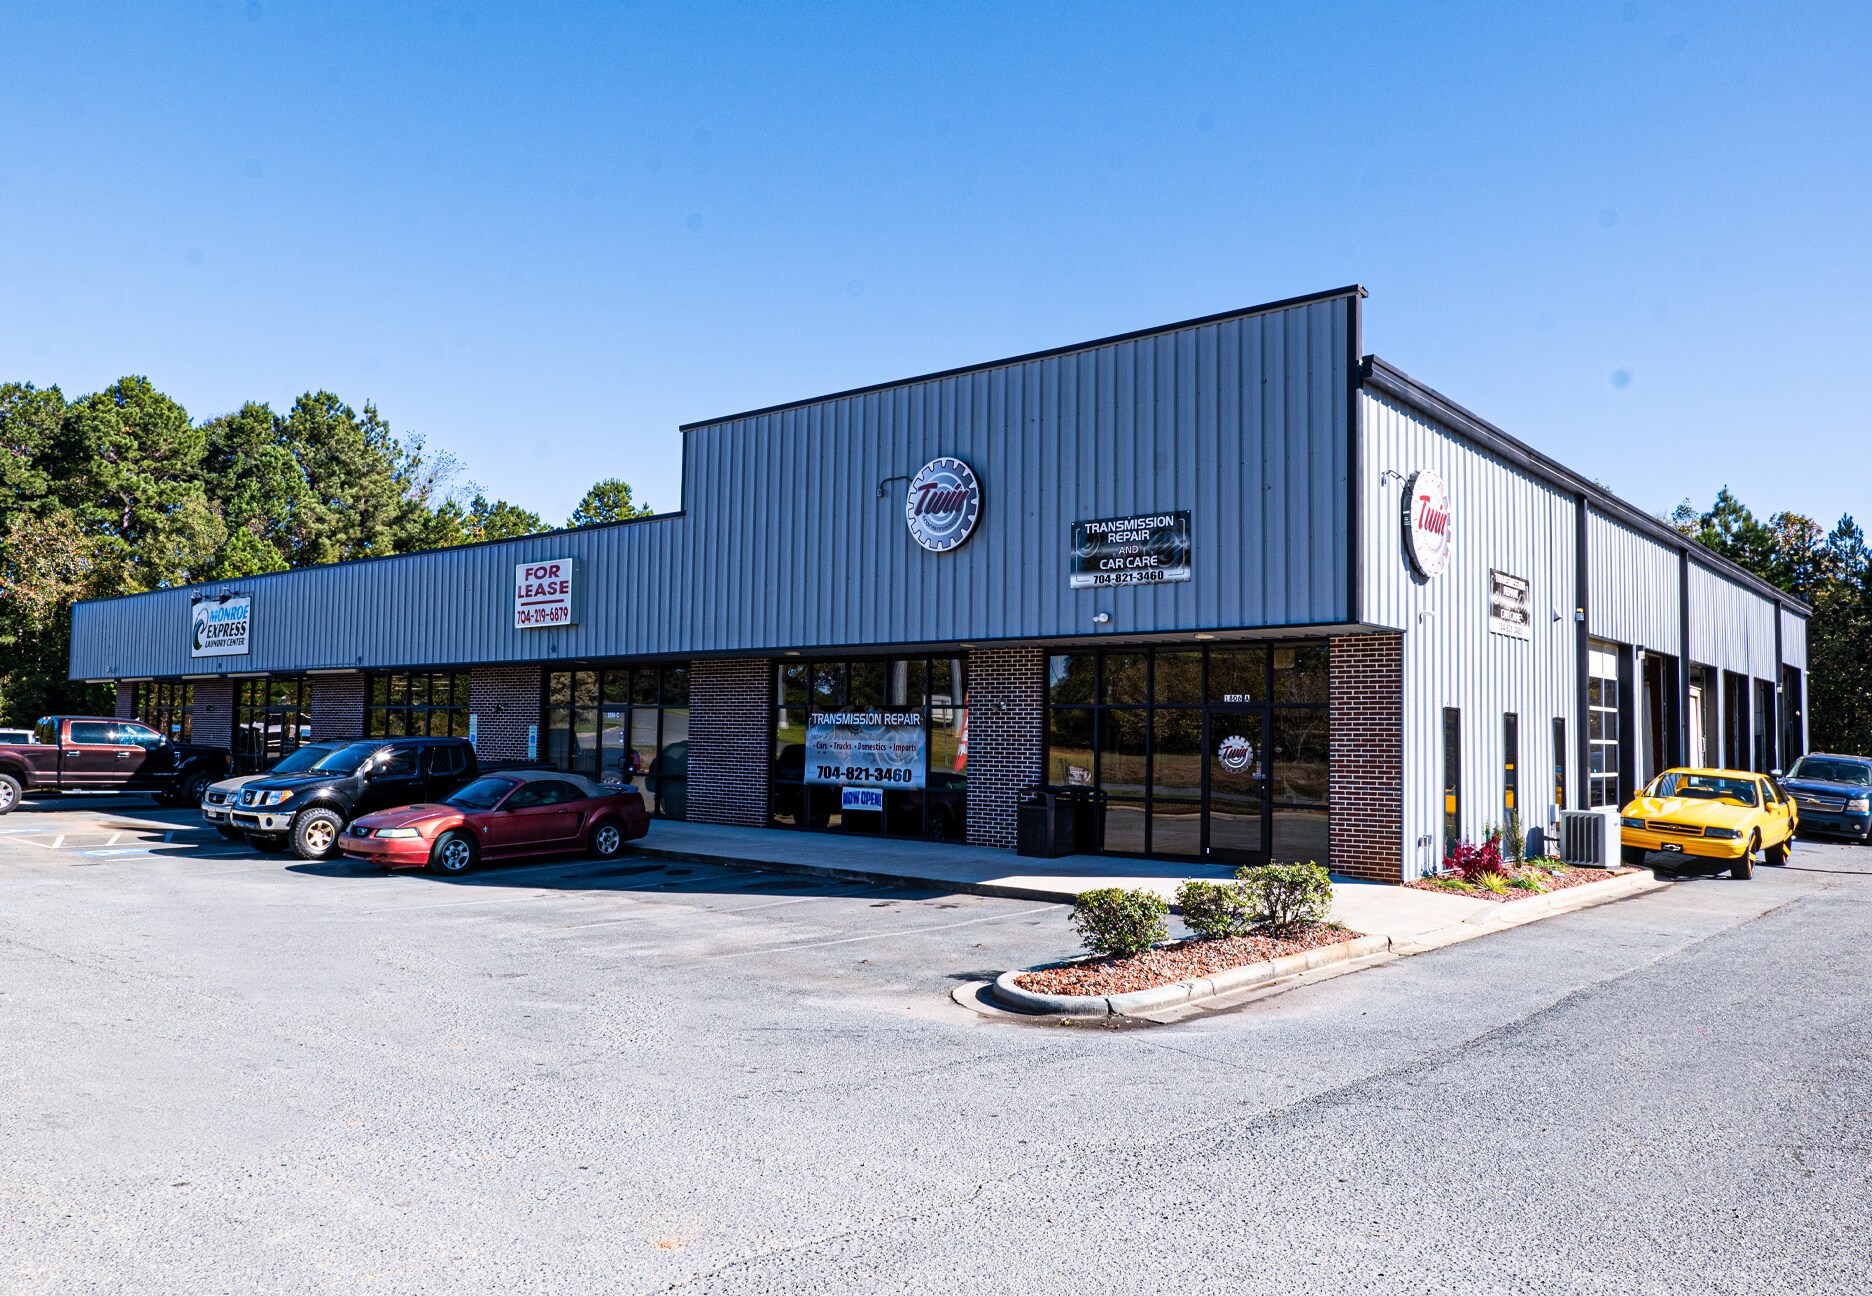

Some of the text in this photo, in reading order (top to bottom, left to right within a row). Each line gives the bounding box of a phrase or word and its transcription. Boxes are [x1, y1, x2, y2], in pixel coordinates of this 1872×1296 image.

[914, 482, 970, 516] Twin
[1418, 495, 1447, 537] Twin
[1085, 515, 1174, 534] TRANSMISSION
[1108, 529, 1150, 543] REPAIR
[1118, 545, 1139, 555] AND
[1099, 555, 1158, 570] CAR CARE
[525, 564, 560, 581] FOR
[1093, 570, 1164, 584] 704-821-3460
[517, 580, 569, 599] LEASE
[209, 604, 249, 623] MONROE
[517, 606, 568, 624] 704-219-6879
[206, 621, 247, 639] EXPRESS
[204, 637, 245, 648] LAUNDRY CENTER
[812, 713, 921, 725] TRANSMISSION REPAIR
[816, 741, 917, 753] Cars Trucks Domestics Imports
[1222, 745, 1249, 760] Twin
[817, 765, 912, 783] 704-821-3460
[843, 791, 860, 806] NOW
